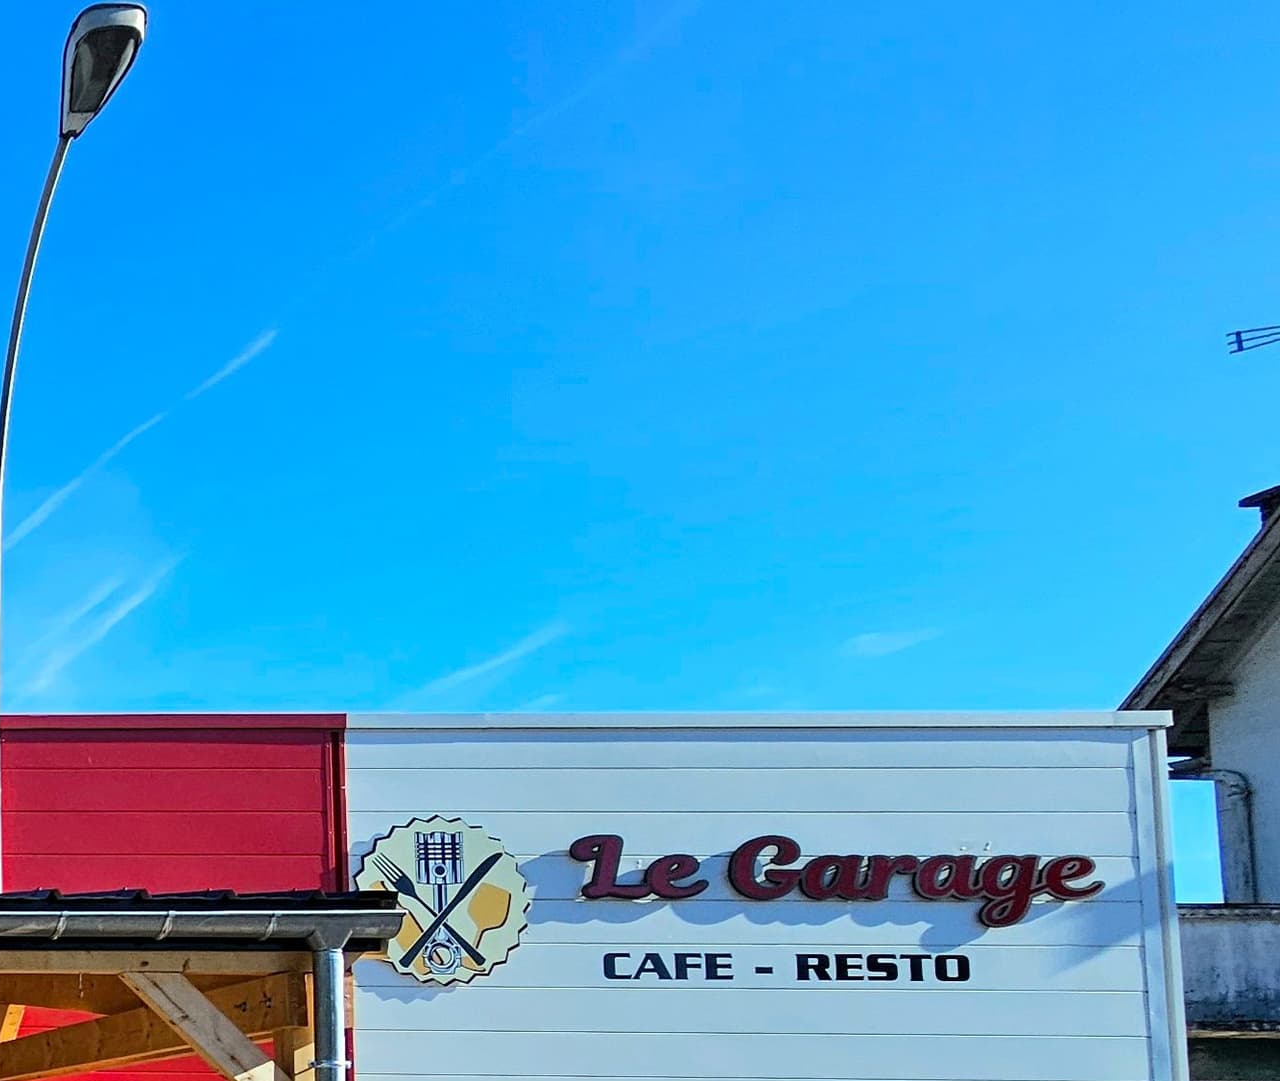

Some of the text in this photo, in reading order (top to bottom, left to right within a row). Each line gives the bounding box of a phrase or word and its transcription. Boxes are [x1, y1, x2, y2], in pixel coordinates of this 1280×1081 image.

[569, 834, 1106, 927] Le Garage
[602, 952, 734, 981] CAFE
[796, 953, 970, 982] RESTO
